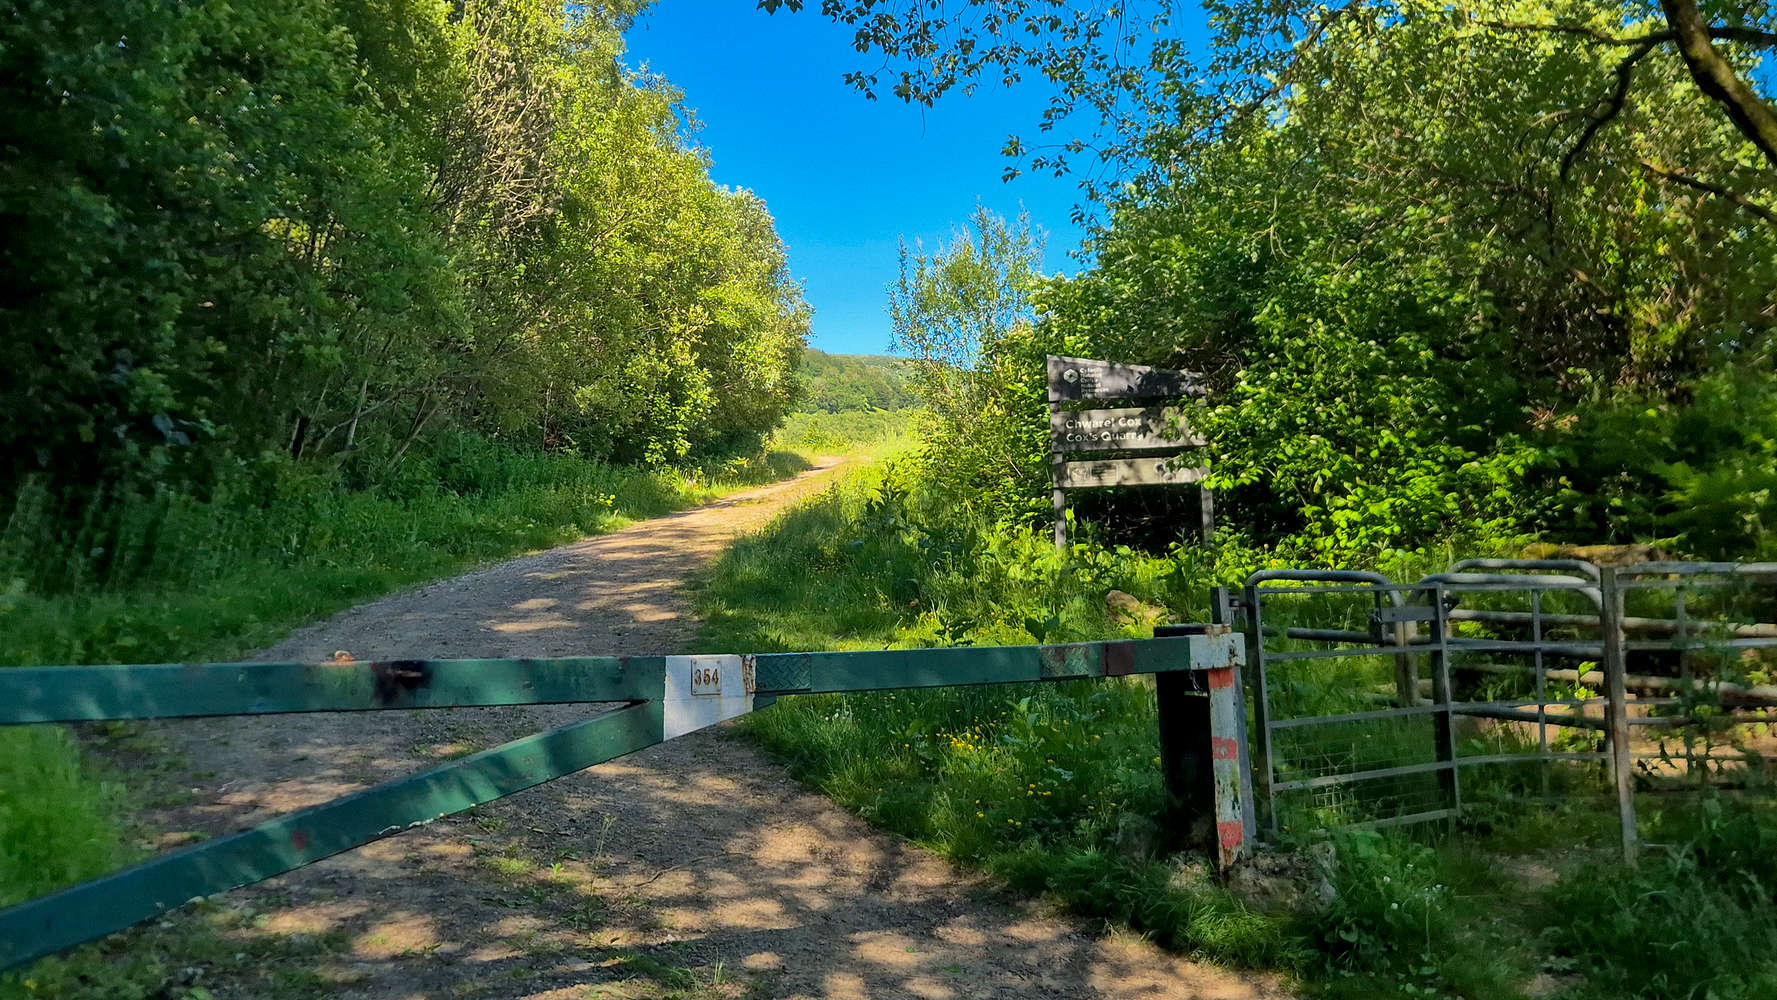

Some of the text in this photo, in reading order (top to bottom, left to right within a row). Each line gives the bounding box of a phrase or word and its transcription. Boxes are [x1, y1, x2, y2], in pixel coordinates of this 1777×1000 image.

[1118, 417, 1142, 427] Cox
[1066, 432, 1099, 442] Cox's
[694, 668, 719, 687] 354
